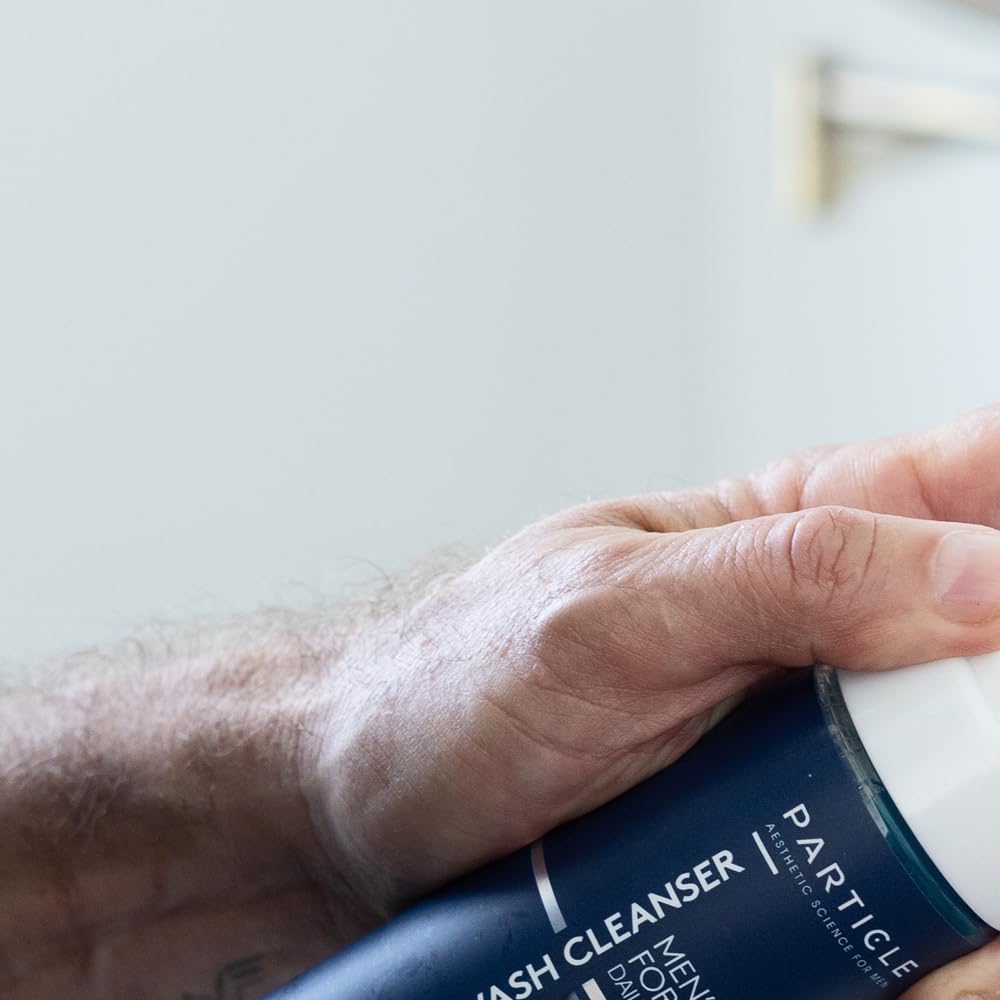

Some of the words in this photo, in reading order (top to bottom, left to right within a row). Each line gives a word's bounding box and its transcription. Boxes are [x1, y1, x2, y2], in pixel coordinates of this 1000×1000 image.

[563, 849, 745, 966] CLEANSER
[765, 823, 812, 895] AESTHETIC
[811, 900, 854, 952] SCIENCE
[852, 954, 872, 974] FOR
[870, 972, 889, 988] MEN
[782, 803, 919, 978] PARTICLE
